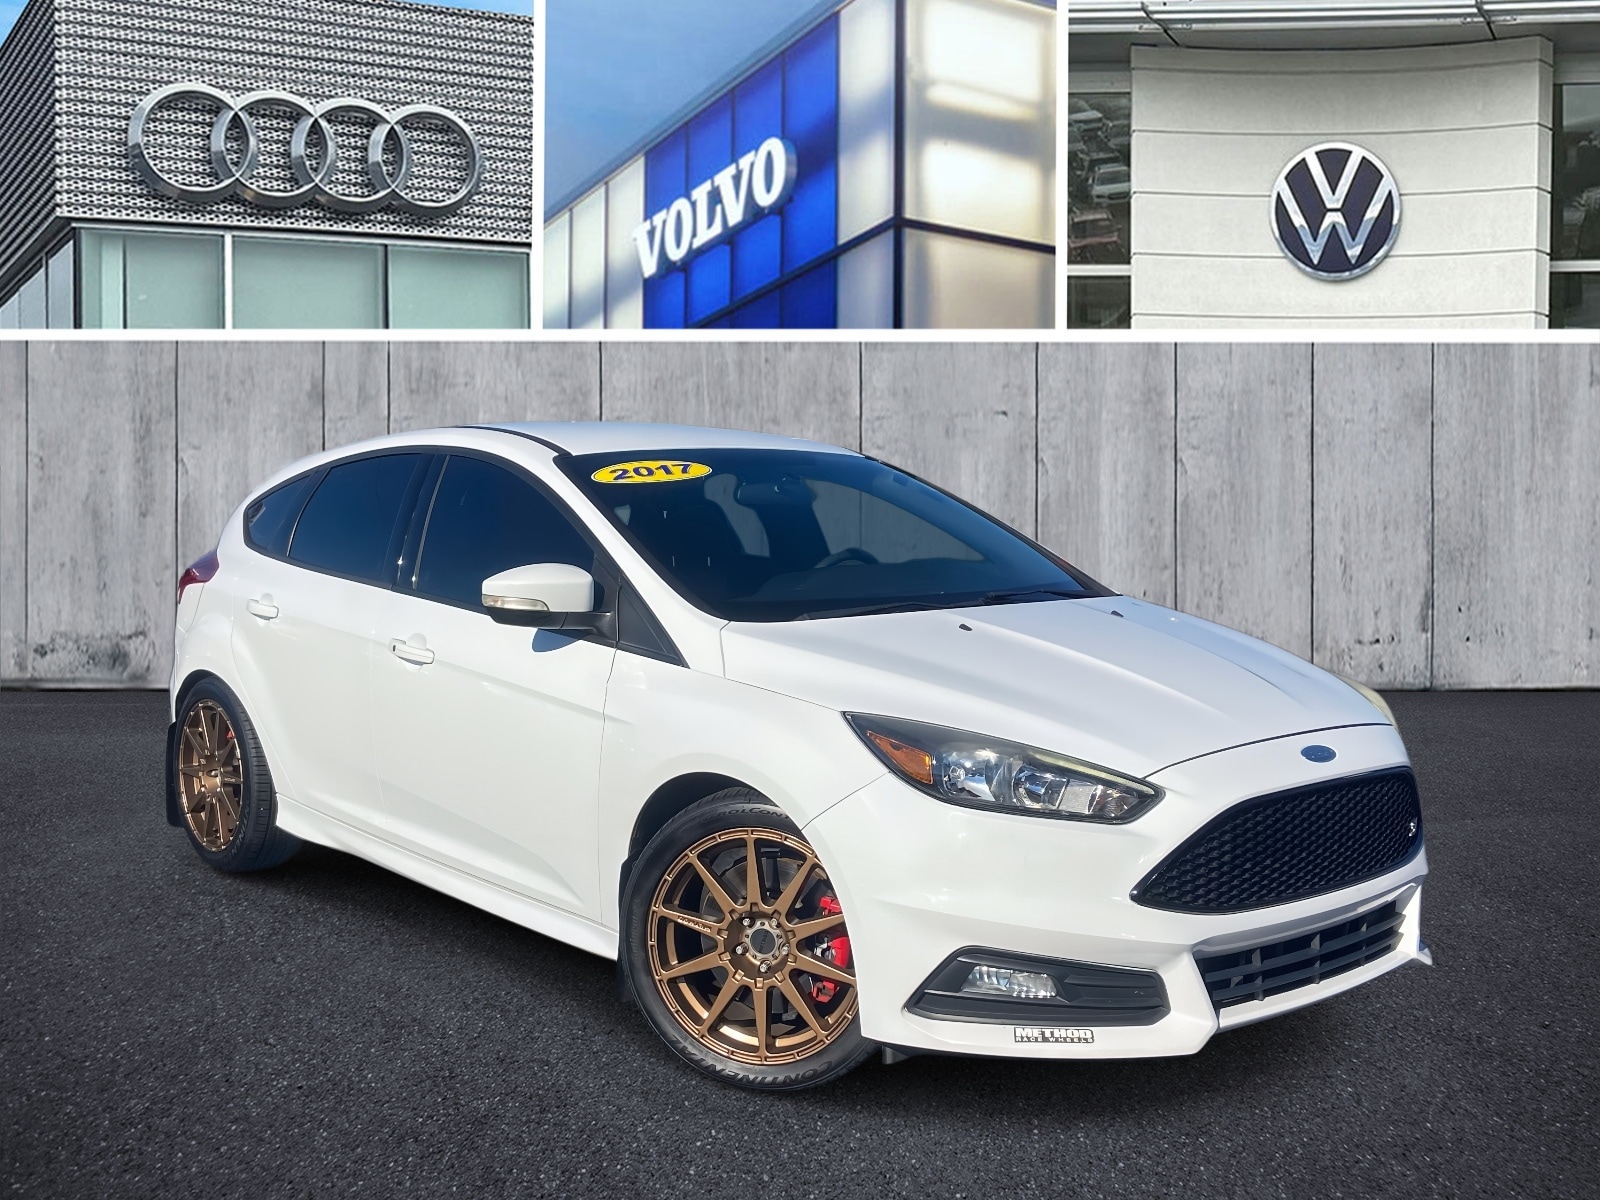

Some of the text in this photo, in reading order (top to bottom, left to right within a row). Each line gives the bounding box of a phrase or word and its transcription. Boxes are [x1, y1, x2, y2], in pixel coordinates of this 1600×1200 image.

[633, 136, 788, 279] VOLVO
[609, 463, 692, 481] 2017
[1015, 1027, 1093, 1039] METHOD
